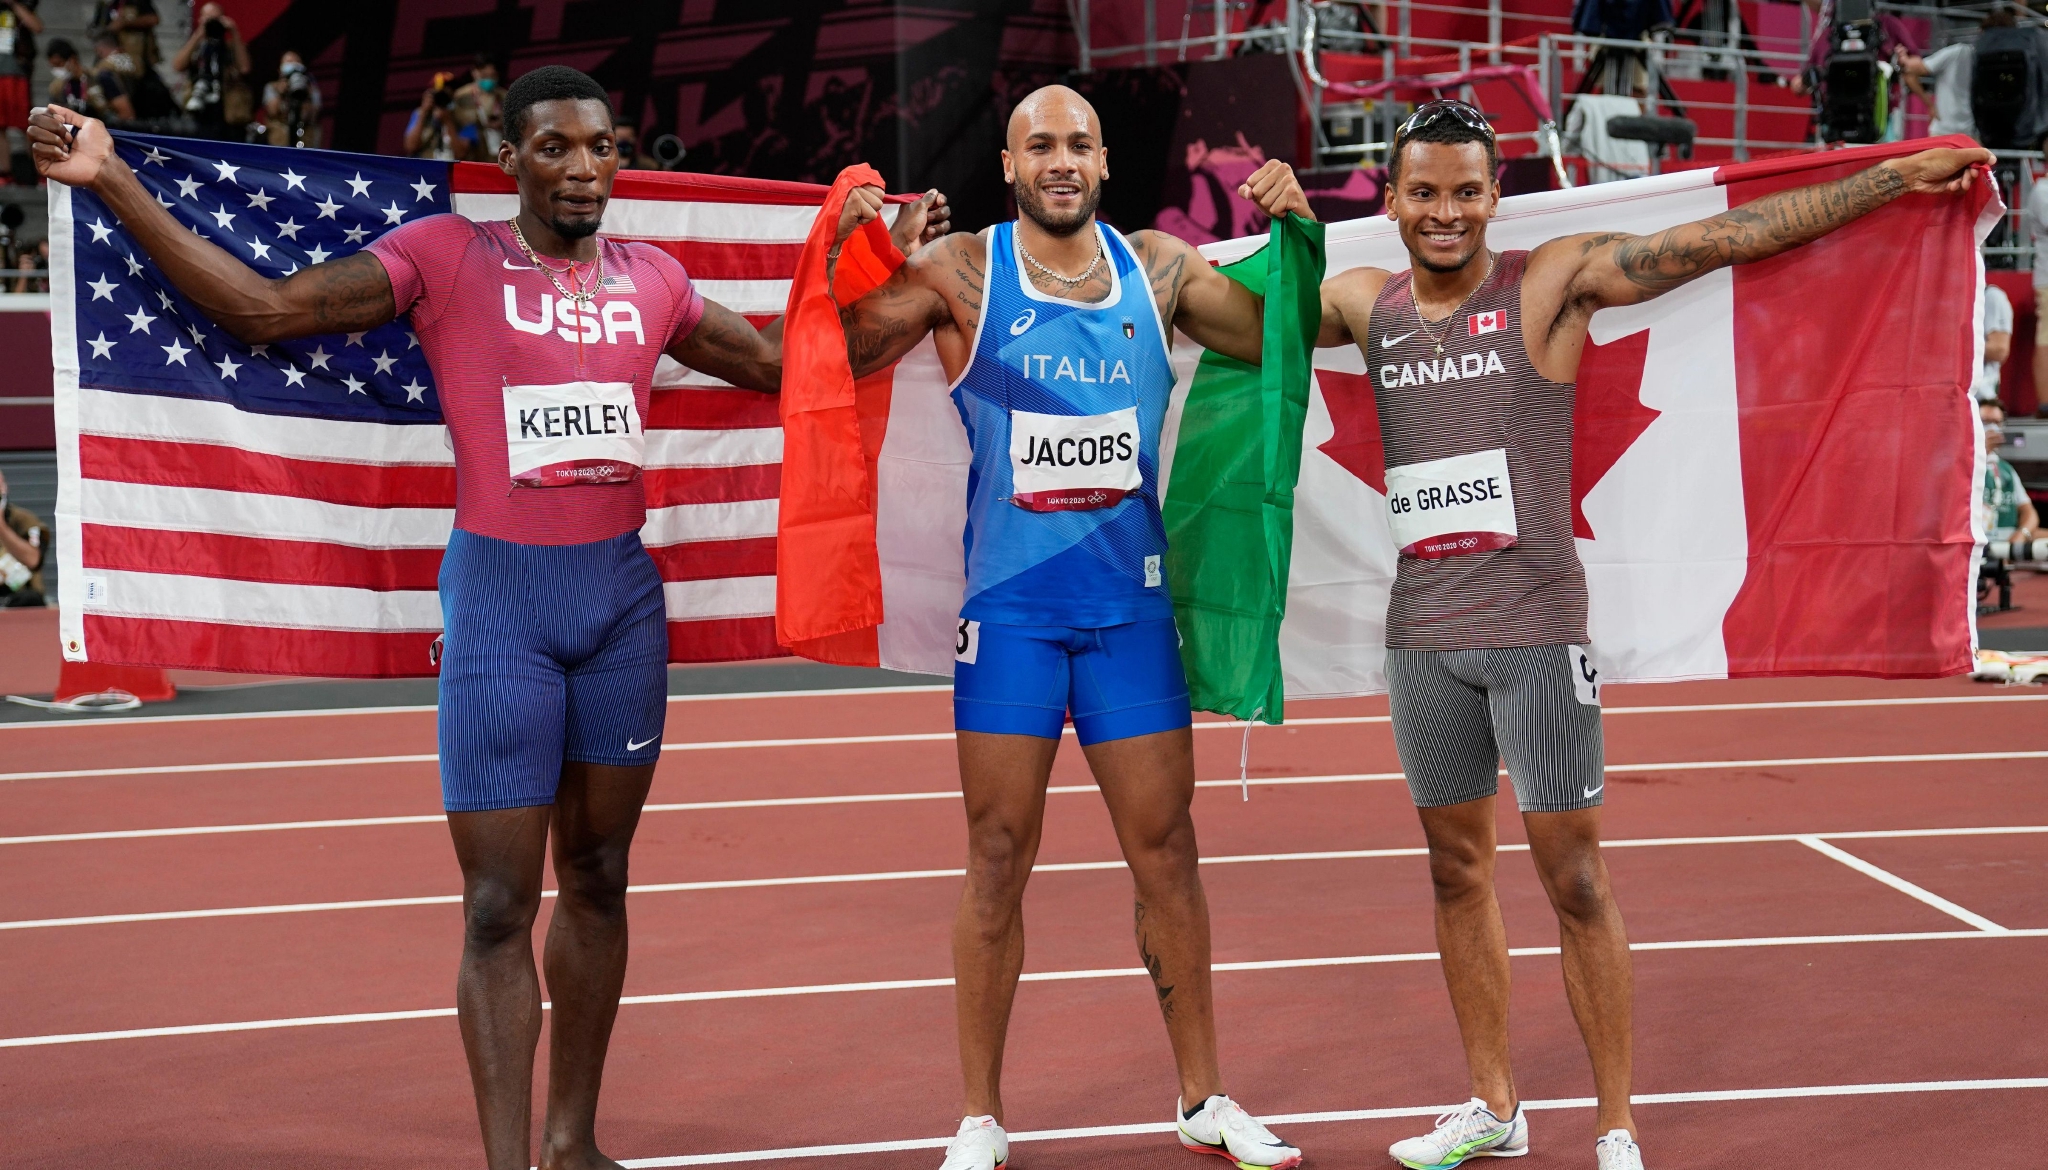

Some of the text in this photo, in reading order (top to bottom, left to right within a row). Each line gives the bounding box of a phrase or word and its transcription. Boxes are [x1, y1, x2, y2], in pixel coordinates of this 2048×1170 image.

[504, 284, 645, 345] USA
[1023, 354, 1131, 384] ITALIA
[1380, 350, 1506, 388] CANADA
[520, 404, 630, 439] KERLEY
[1021, 432, 1132, 466] JACOBS
[1391, 476, 1502, 514] de GRASSE
[1425, 542, 1457, 552] TOKYO 2020
